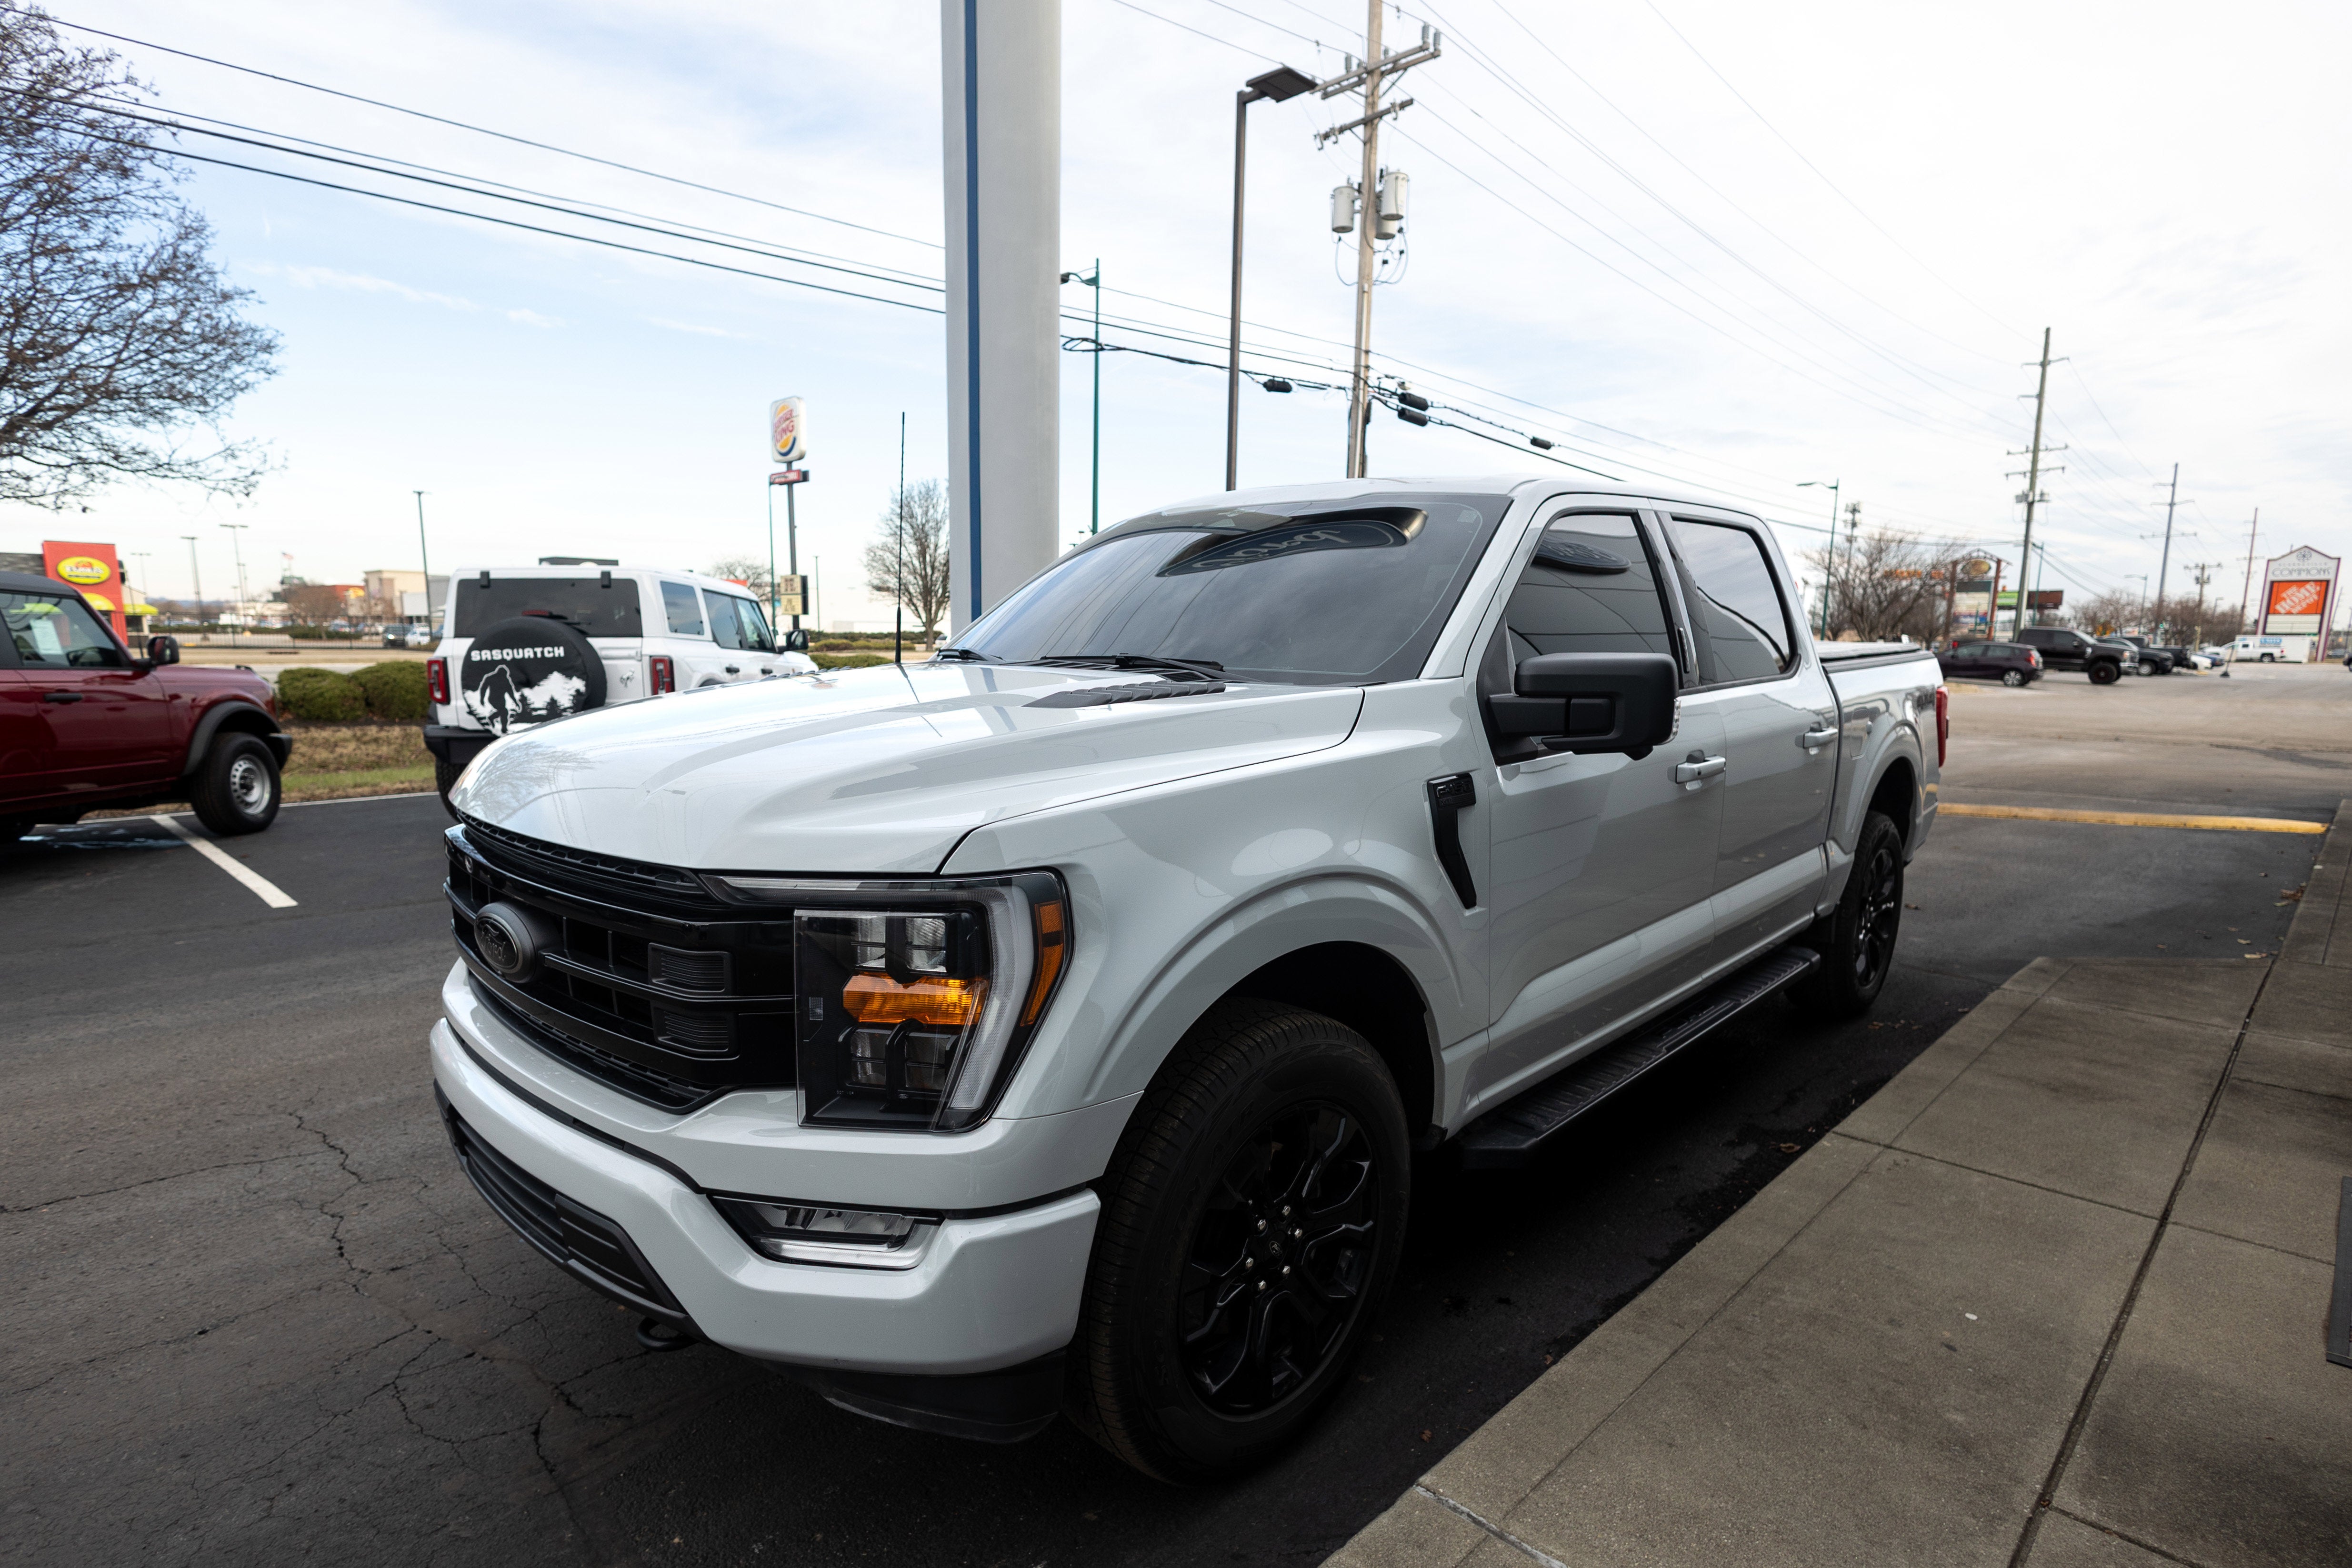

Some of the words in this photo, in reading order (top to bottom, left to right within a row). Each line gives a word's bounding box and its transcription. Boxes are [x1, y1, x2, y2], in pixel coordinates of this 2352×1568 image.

[2274, 581, 2316, 614] HOME
[2291, 593, 2318, 614] DEPOT
[470, 646, 565, 661] SASQUATCH
[480, 924, 506, 961] Ford
